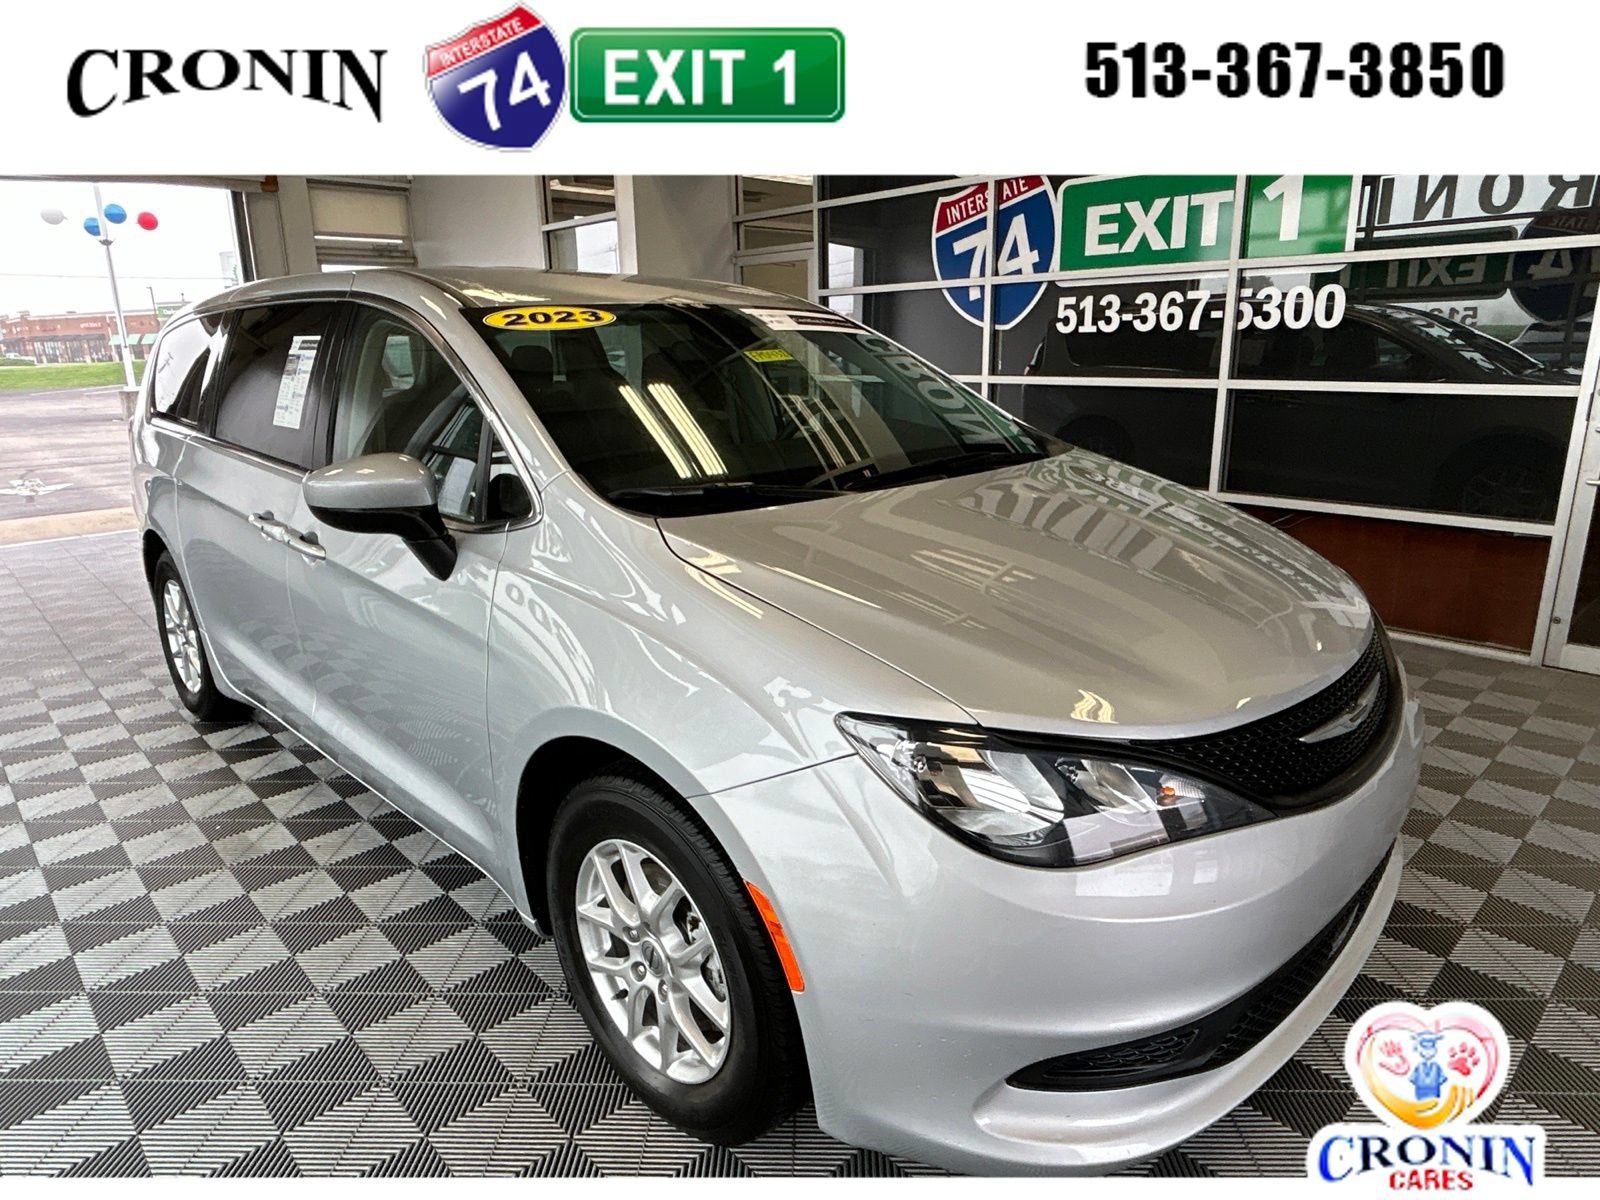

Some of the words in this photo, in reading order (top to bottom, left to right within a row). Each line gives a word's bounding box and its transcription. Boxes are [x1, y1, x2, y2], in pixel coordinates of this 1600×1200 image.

[946, 177, 1029, 225] INTERATE
[1084, 190, 1235, 257] EXIT
[1263, 174, 1304, 242] 1
[952, 213, 1040, 302] 74
[502, 310, 604, 327] 2023
[1055, 284, 1347, 335] 513-367-5300
